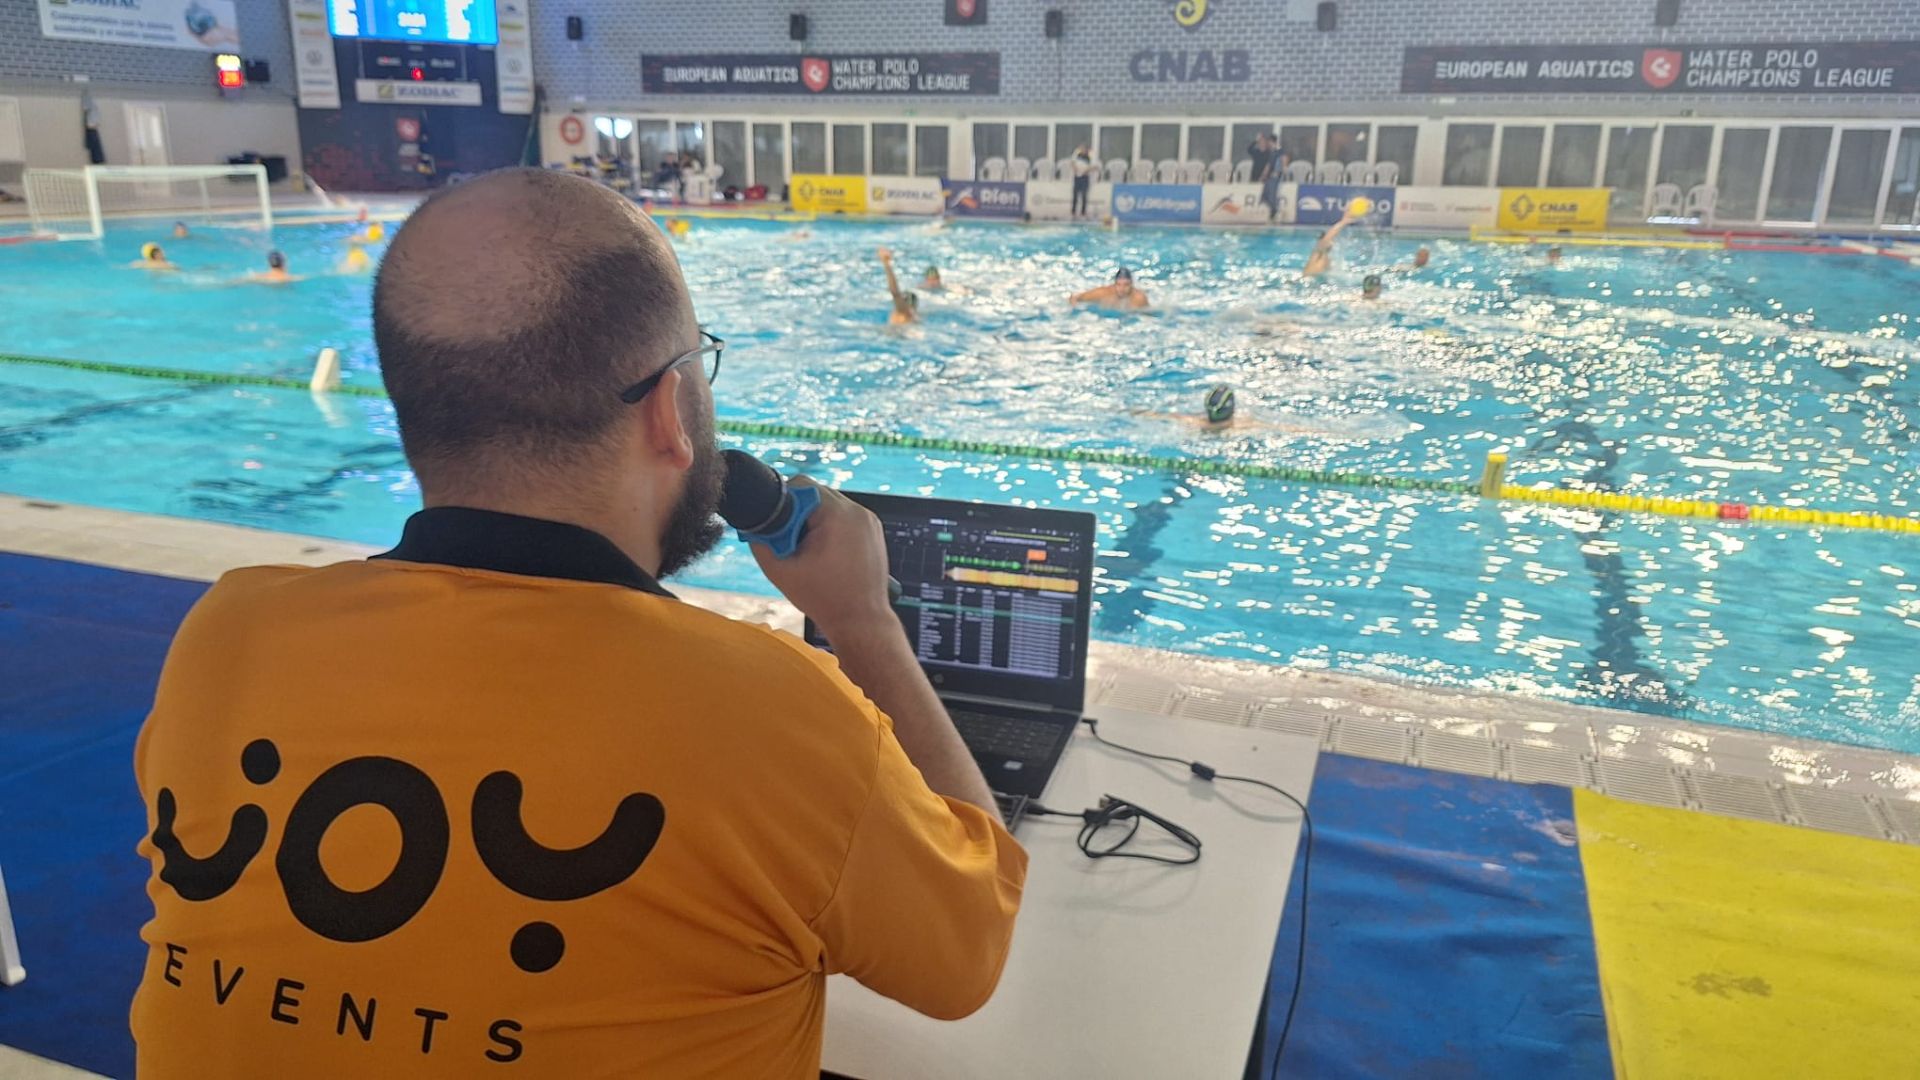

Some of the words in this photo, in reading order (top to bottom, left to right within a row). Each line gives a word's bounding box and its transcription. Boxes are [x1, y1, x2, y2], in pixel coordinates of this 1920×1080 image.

[832, 58, 876, 75] WATER
[883, 58, 919, 75] POLO
[1130, 49, 1252, 83] CNAB
[1688, 49, 1753, 68] WATER
[1764, 49, 1818, 69] POLO
[663, 66, 728, 83] EUROPEAN
[732, 66, 799, 83] AQUATICS
[1435, 60, 1528, 79] EUROPEAN
[1537, 59, 1634, 79] AQUATICS
[1686, 68, 1801, 87] CHAMPIONS
[1813, 67, 1894, 88] LEAGUE
[832, 74, 911, 91] CHAMPIONS
[917, 74, 970, 91] LEAGUE
[1326, 196, 1391, 214] TUO
[1538, 202, 1579, 213] CNAB
[164, 943, 524, 1063] EVENTS
